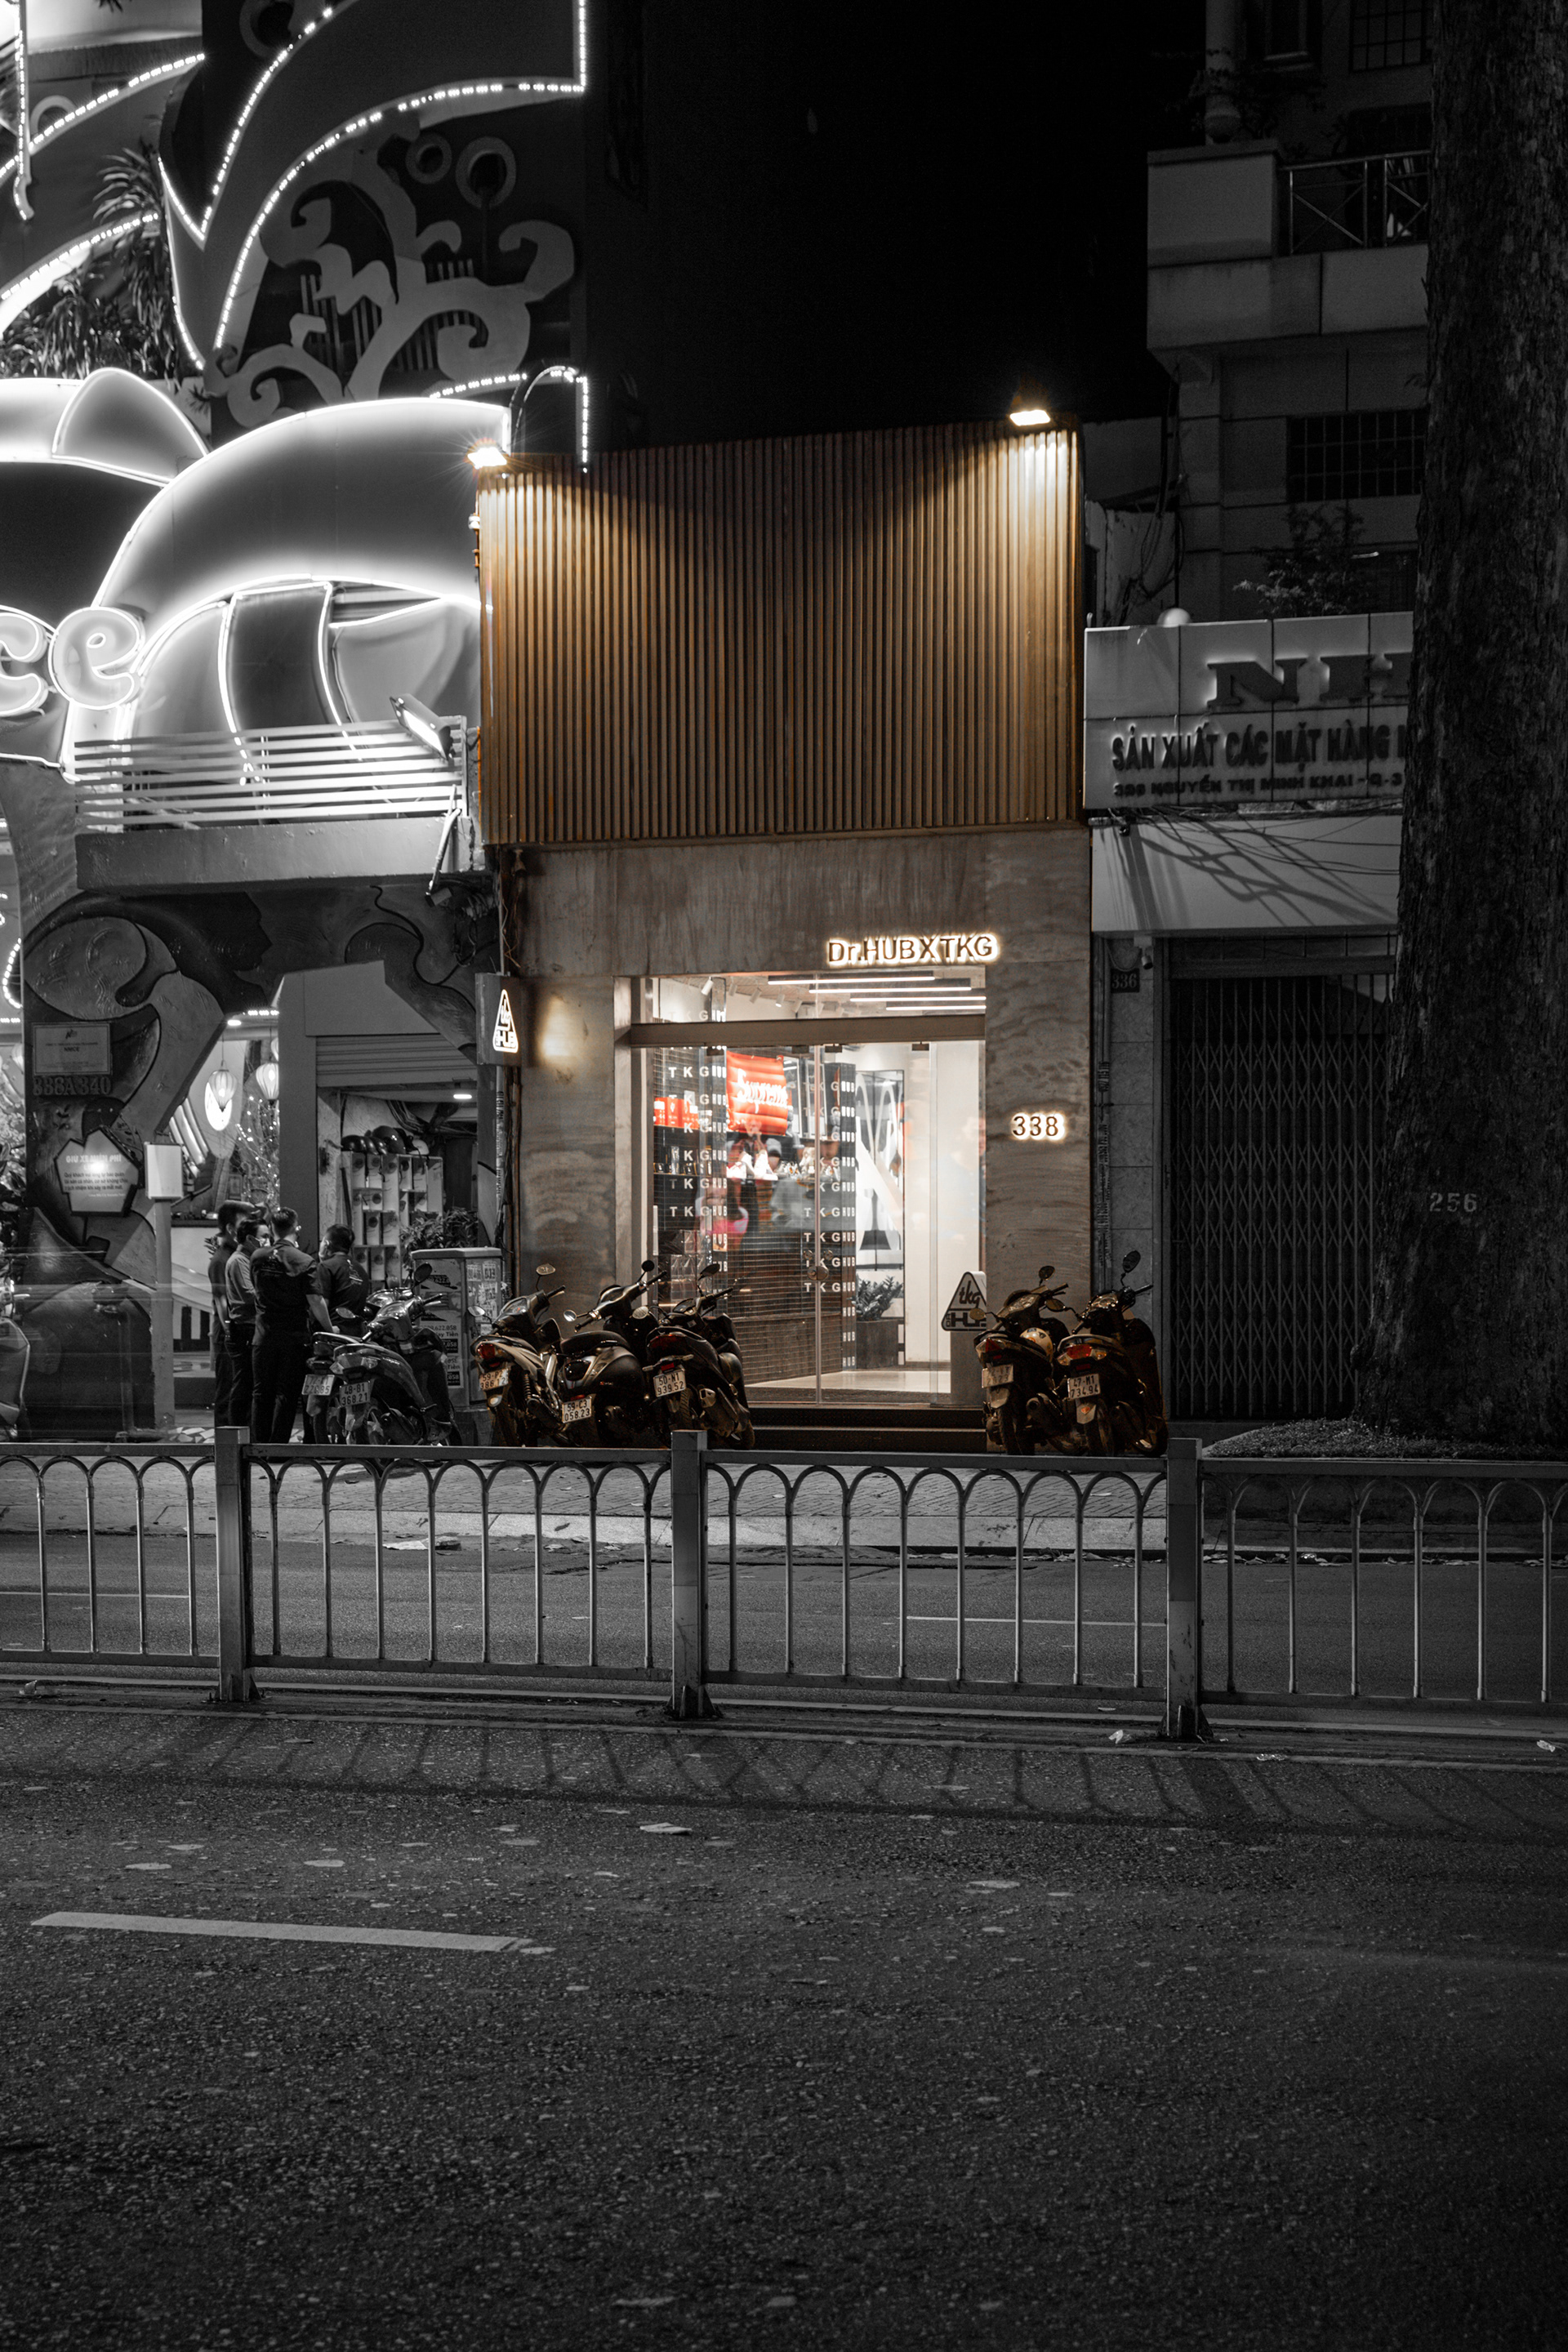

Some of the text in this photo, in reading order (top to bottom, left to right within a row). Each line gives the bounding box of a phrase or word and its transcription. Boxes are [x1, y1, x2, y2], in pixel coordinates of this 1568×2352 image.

[1112, 724, 1156, 770] SẢN
[1161, 721, 1219, 768] XUẤT
[1226, 724, 1269, 767] CÁC
[1274, 722, 1321, 773] MẶT
[1328, 719, 1391, 762] HÀNG
[1227, 778, 1255, 795] THỊ
[1260, 777, 1306, 791] MINH
[1310, 774, 1353, 790] KHAI
[1112, 973, 1137, 988] 336
[1013, 1115, 1060, 1137] 338
[1430, 1192, 1477, 1212] 256
[482, 1369, 503, 1382] 59-P2
[658, 1372, 679, 1386] 50-N1
[1073, 1375, 1094, 1388] 47-M1
[657, 1380, 684, 1395] 939.52
[1071, 1384, 1098, 1398] 734.94
[341, 1392, 368, 1406] 368.21
[567, 1399, 587, 1412] 59-C3
[564, 1407, 590, 1422] 058.23
